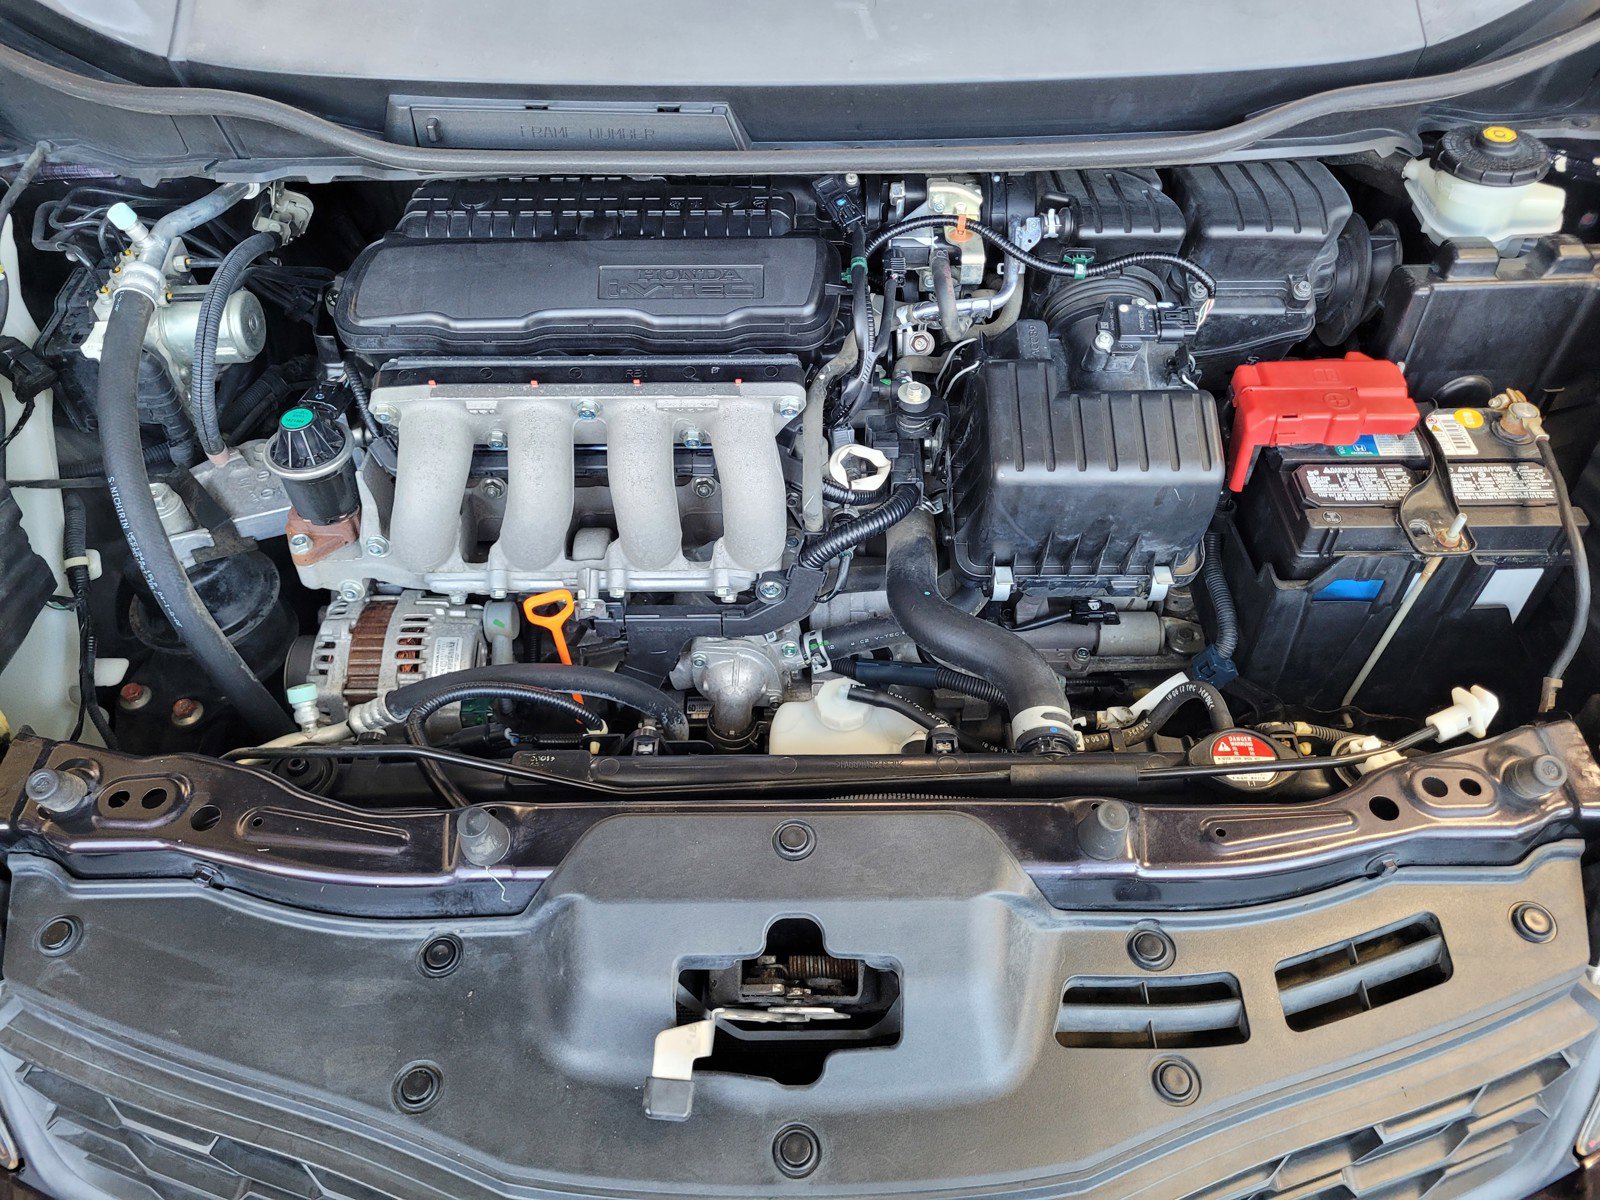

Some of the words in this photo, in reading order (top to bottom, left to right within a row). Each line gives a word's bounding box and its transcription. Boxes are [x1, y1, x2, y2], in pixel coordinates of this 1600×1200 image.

[519, 125, 575, 139] FRAME
[588, 127, 656, 140] NUMBER
[637, 269, 743, 282] HONDA
[607, 280, 754, 298] i-VTEC
